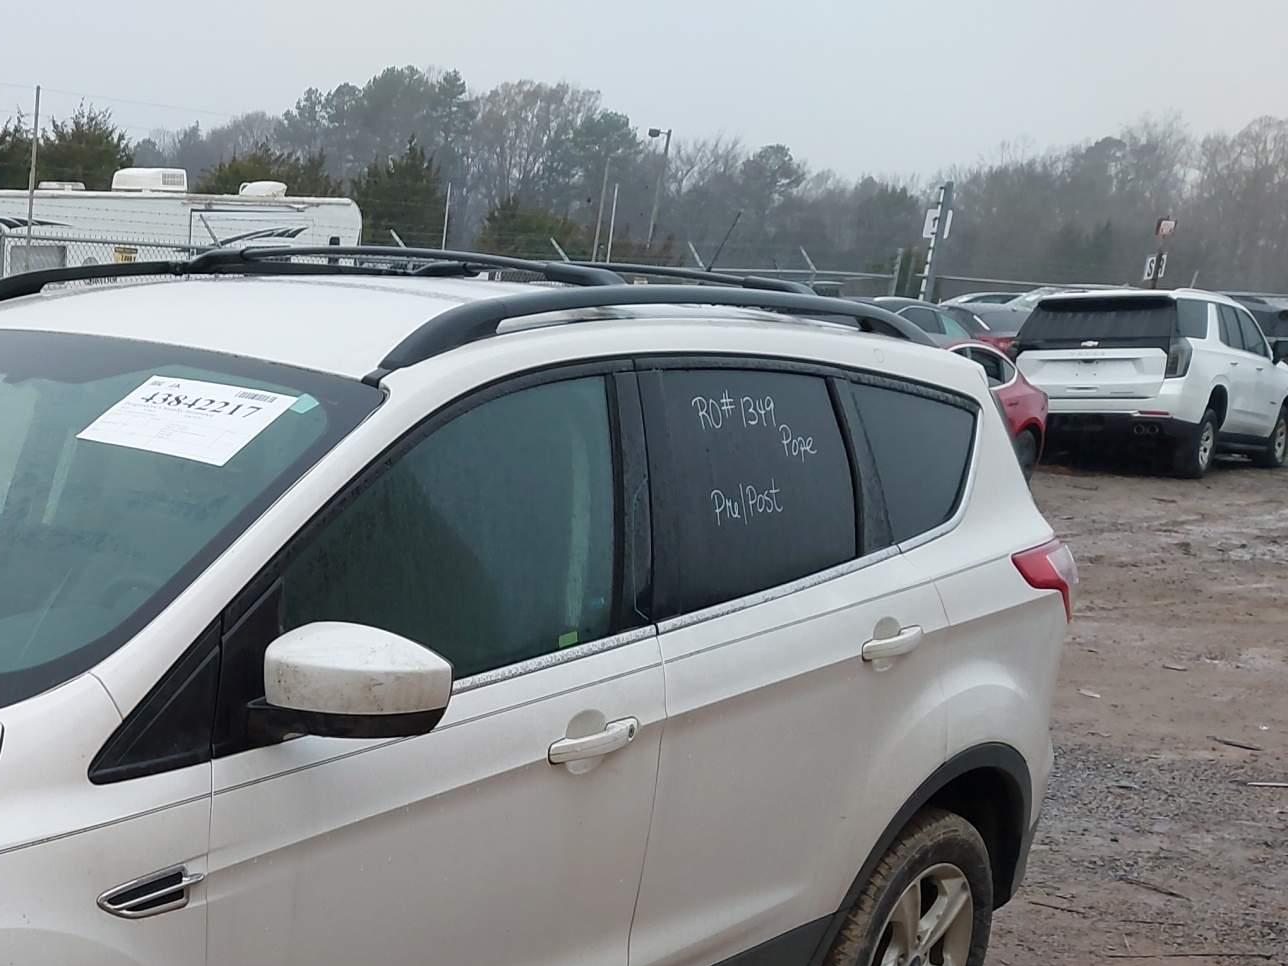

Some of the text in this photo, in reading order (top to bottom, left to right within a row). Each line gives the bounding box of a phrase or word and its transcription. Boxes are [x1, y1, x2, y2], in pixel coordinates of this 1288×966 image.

[141, 391, 263, 418] 43842217
[691, 389, 777, 430] RO# 1349
[778, 424, 817, 464] Pope
